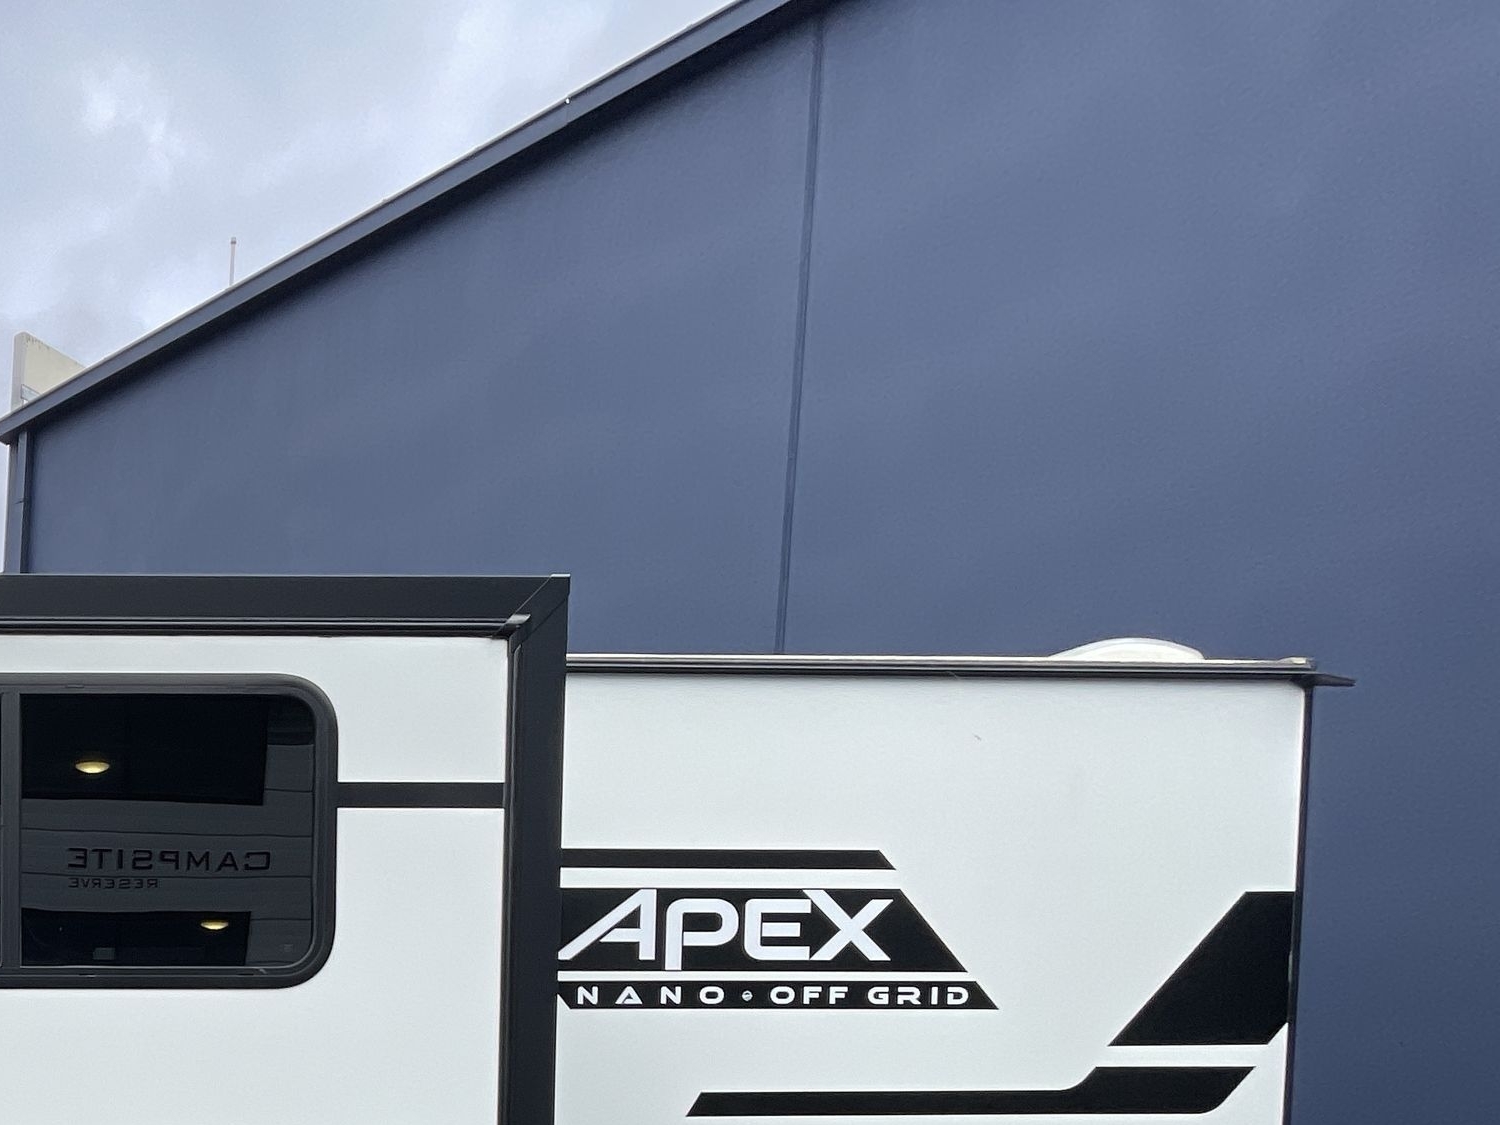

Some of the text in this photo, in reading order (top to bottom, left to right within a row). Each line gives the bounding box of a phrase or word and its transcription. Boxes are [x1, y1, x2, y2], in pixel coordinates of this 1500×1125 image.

[557, 888, 894, 971] APEX
[576, 985, 970, 1006] NANO OFF GRID
